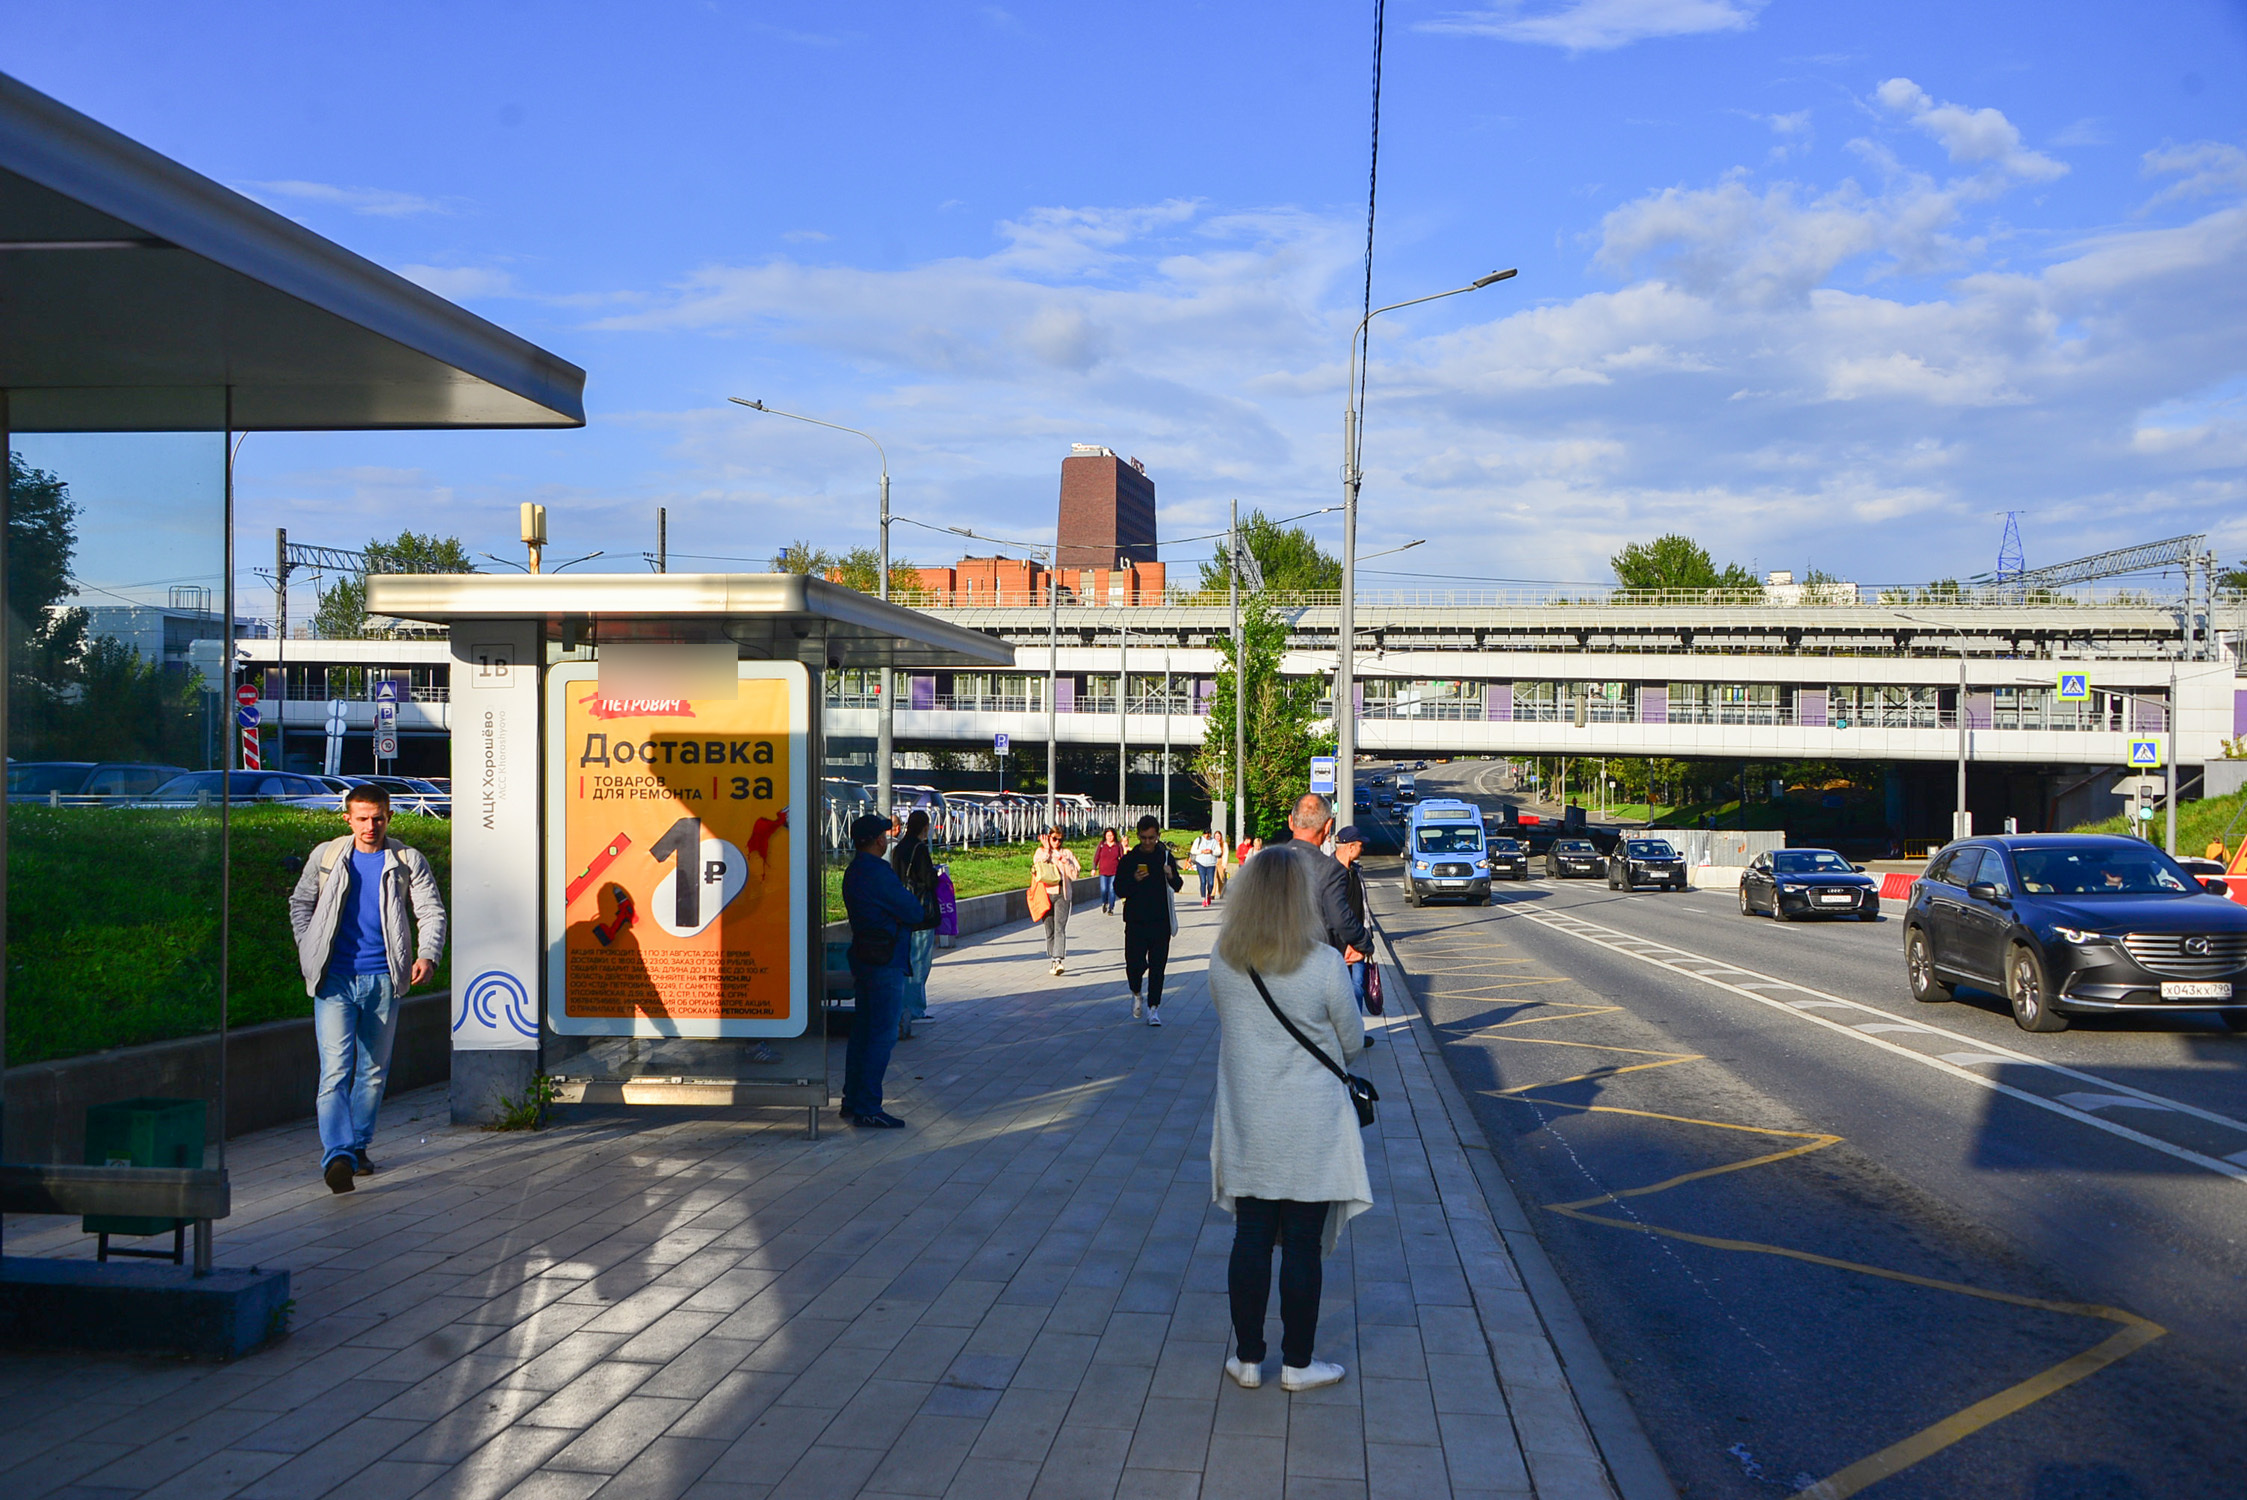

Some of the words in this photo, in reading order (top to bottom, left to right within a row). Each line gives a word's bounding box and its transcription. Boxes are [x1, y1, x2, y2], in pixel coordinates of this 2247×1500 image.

[602, 699, 681, 712] ПЕТРОВИЧ
[481, 711, 497, 787] Хорошёво
[580, 733, 774, 768] Доставка
[498, 776, 507, 800] MCC
[594, 776, 666, 787] ТОВАРОВ
[729, 776, 774, 800] за
[593, 789, 625, 801] ДЛЯ
[630, 788, 702, 800] РЕМОНТА
[482, 790, 497, 830] МЦК
